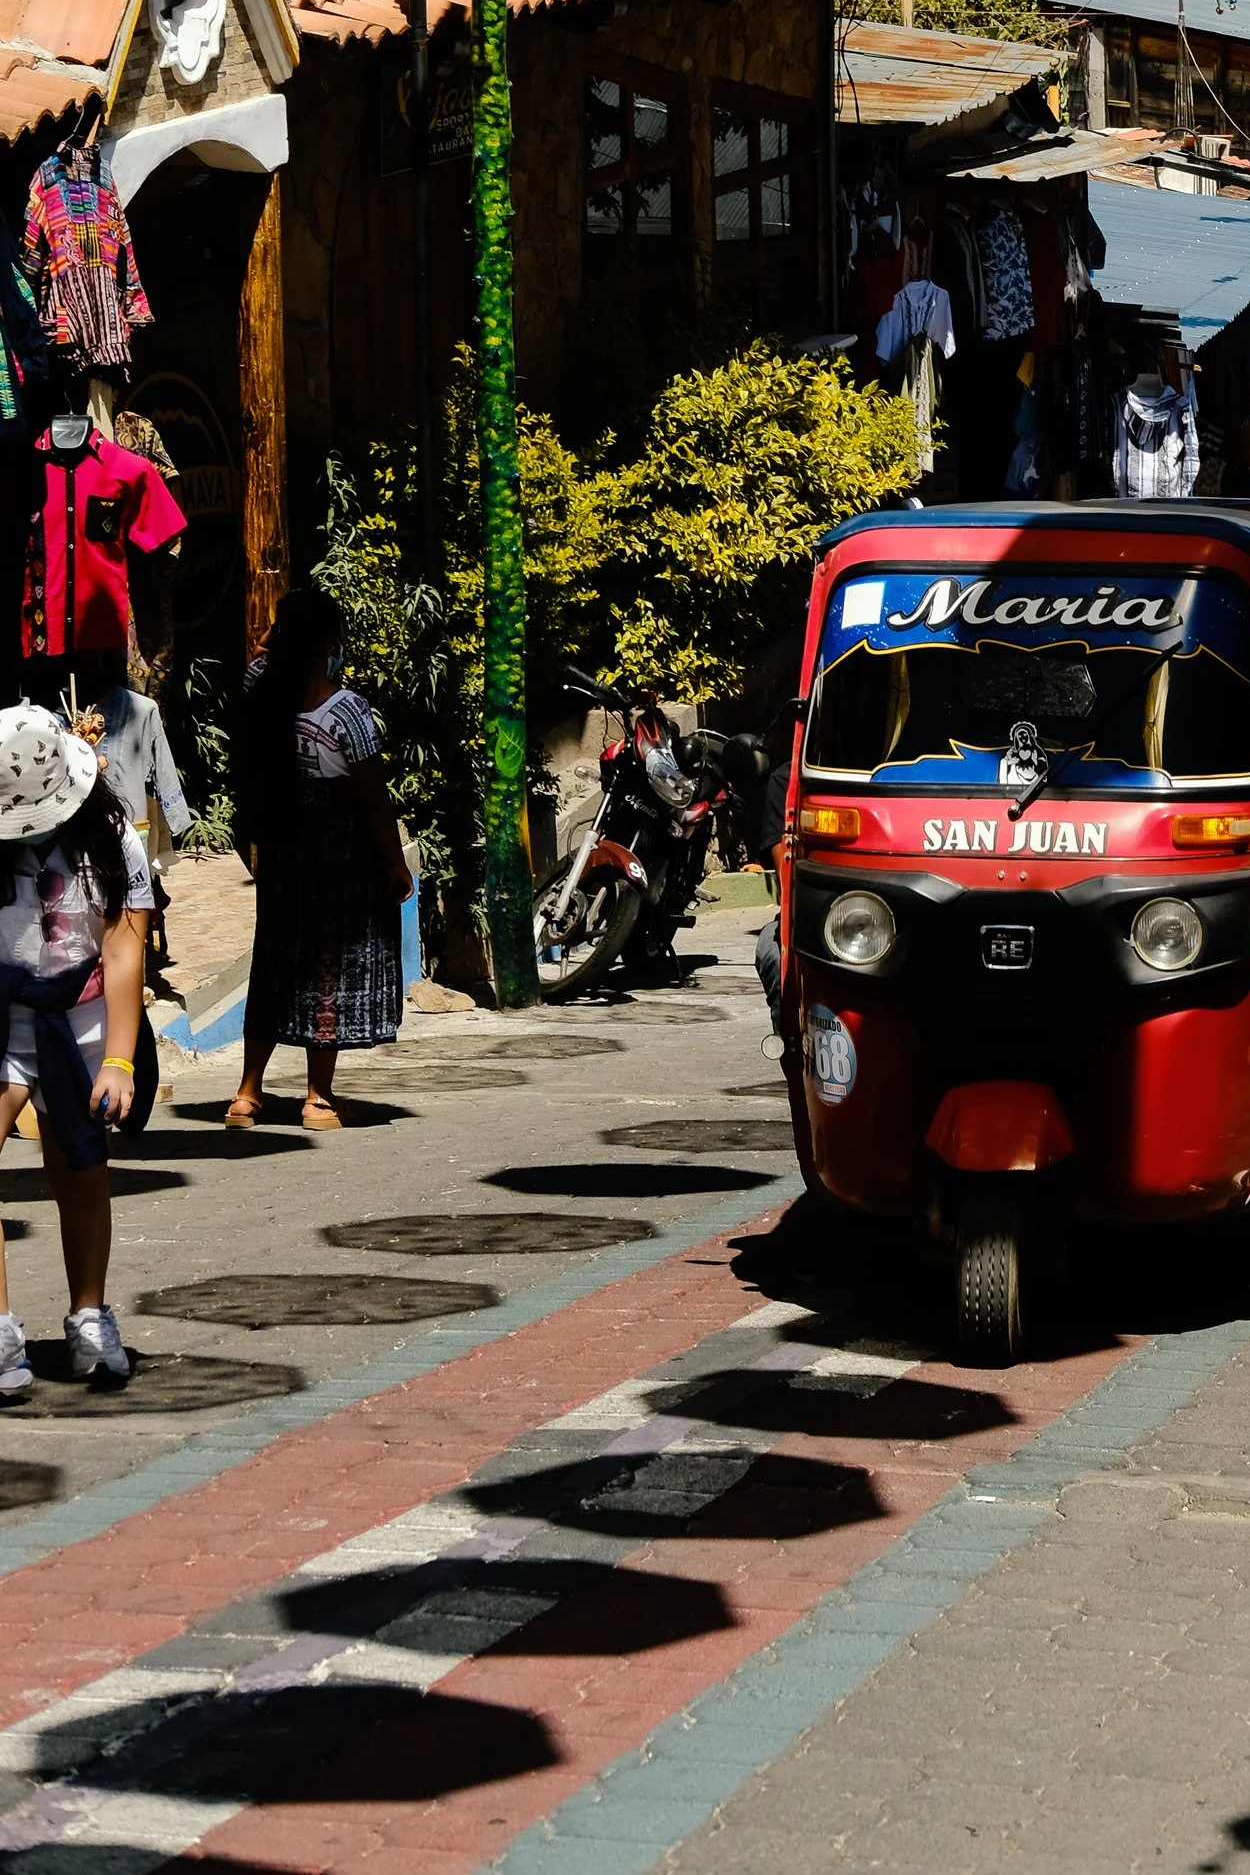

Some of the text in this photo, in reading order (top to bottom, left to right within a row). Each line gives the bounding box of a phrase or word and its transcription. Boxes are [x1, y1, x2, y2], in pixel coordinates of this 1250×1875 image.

[887, 576, 1183, 634] Maria
[922, 818, 1109, 854] SAN JUAN
[991, 940, 1025, 959] RE
